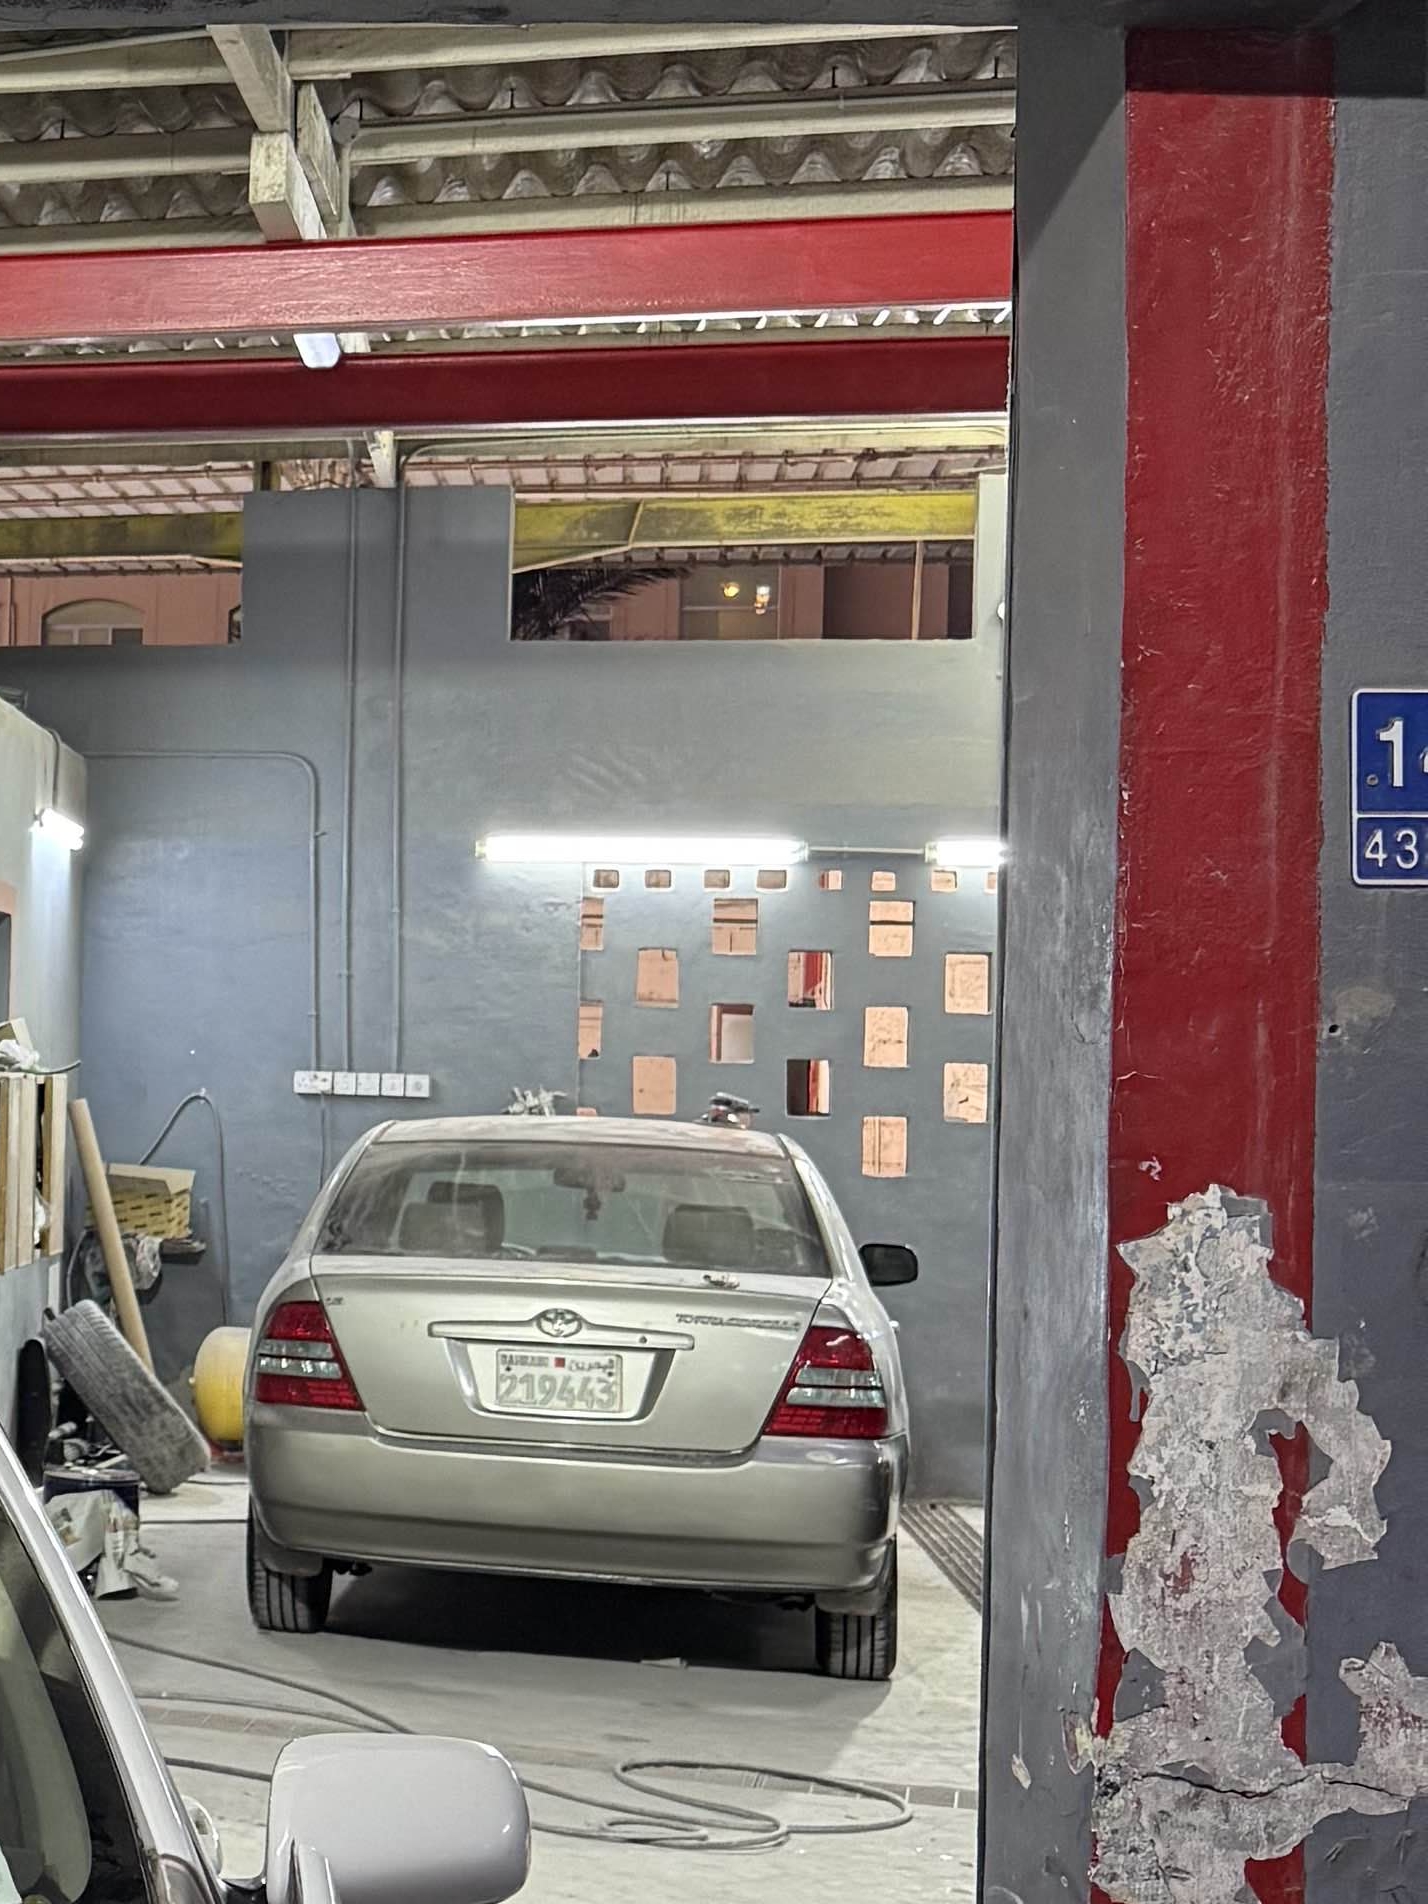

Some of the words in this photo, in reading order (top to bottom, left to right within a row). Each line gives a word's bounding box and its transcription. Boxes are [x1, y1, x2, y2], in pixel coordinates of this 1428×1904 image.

[1379, 718, 1428, 787] 1
[1364, 828, 1428, 870] 43
[498, 1373, 617, 1409] 219443
